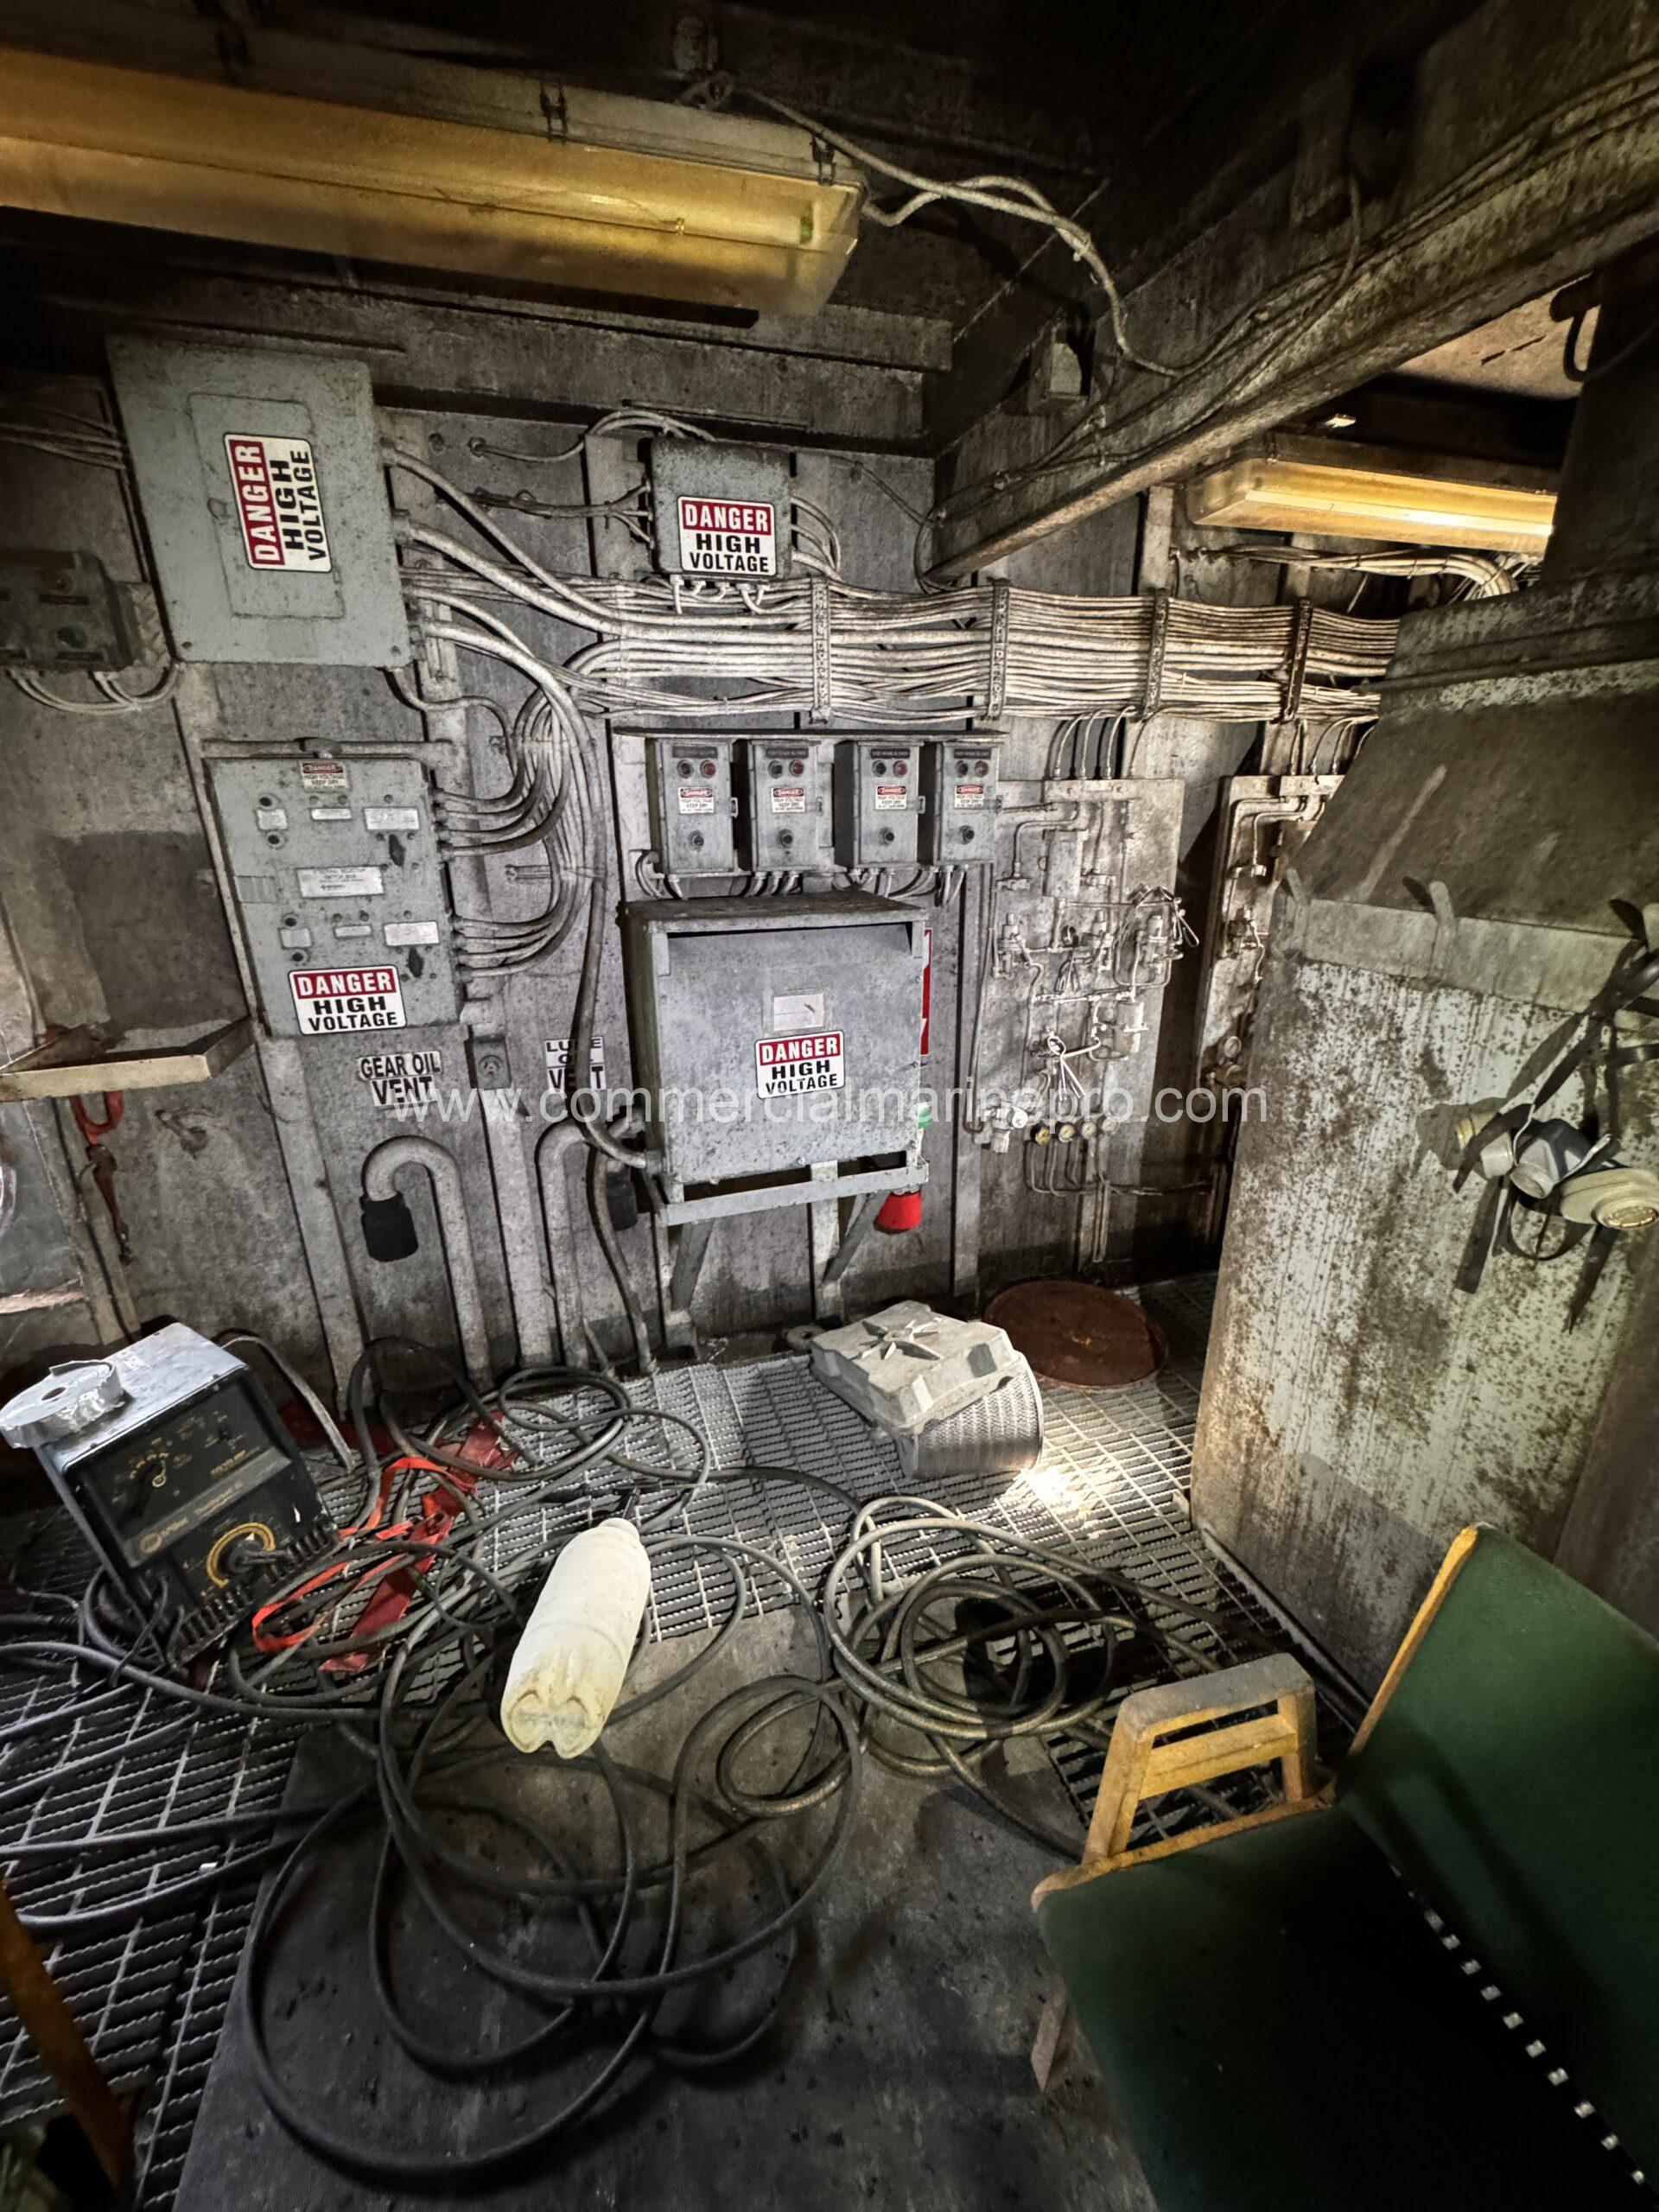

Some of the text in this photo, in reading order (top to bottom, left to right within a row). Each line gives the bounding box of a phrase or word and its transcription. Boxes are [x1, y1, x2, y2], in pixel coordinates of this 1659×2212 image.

[235, 444, 281, 562] DANGER
[270, 460, 305, 550] HIGH
[290, 450, 327, 560] VOLTAGE
[684, 504, 768, 531] DANGER
[696, 533, 760, 554] HIGH
[690, 552, 769, 573] VOLTAGE
[297, 971, 393, 995] DANGER
[313, 996, 386, 1014] HIGH
[308, 1011, 397, 1032] VOLTAGE
[546, 1038, 602, 1052] LUE
[761, 1036, 838, 1063] DANGER
[360, 1052, 441, 1080] GEAR OIL
[549, 1065, 604, 1090] VET
[772, 1059, 830, 1080] HIGH
[372, 1075, 433, 1105] VENT
[766, 1074, 838, 1095] VOLTAGE
